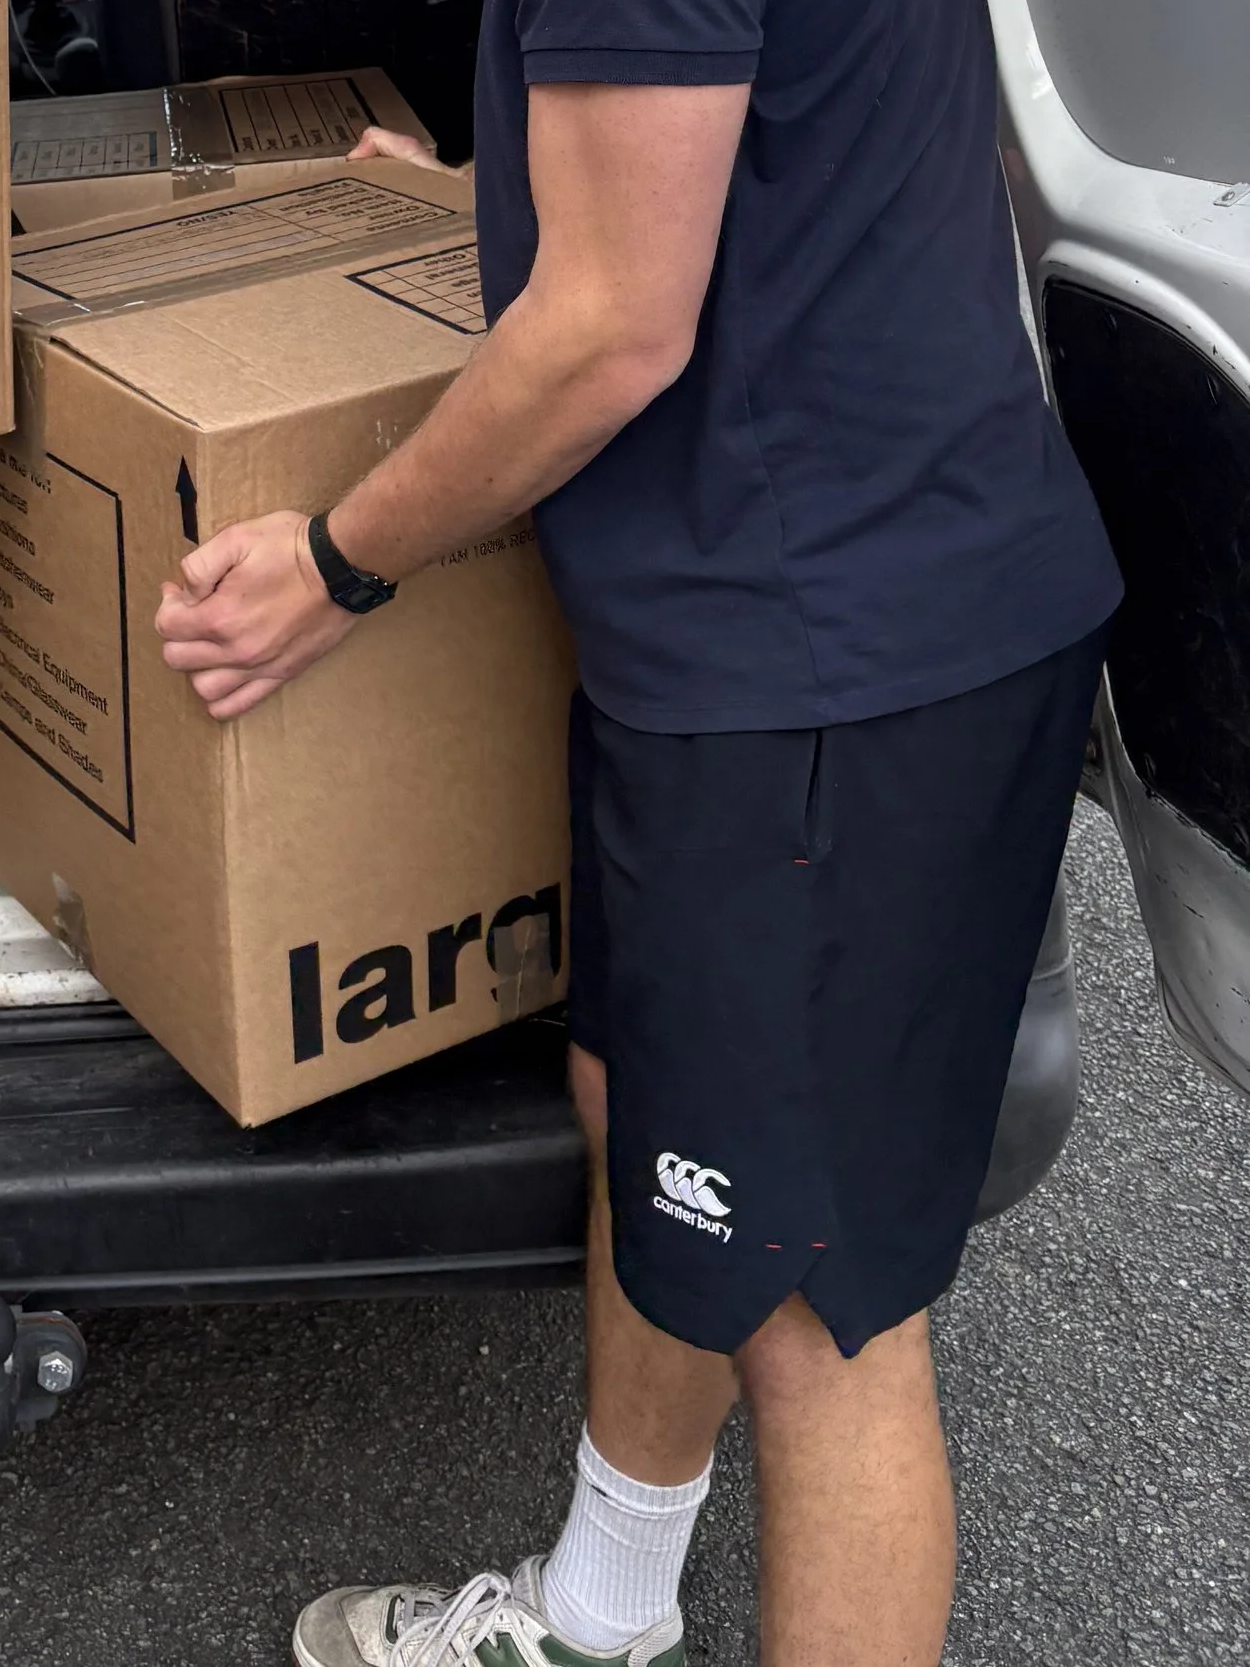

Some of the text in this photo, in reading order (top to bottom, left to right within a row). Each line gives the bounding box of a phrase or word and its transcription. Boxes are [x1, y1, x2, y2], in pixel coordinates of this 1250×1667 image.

[43, 651, 109, 716] Equipment
[58, 732, 104, 784] Shades
[288, 881, 561, 1065] larg
[653, 1195, 733, 1244] canterbury
